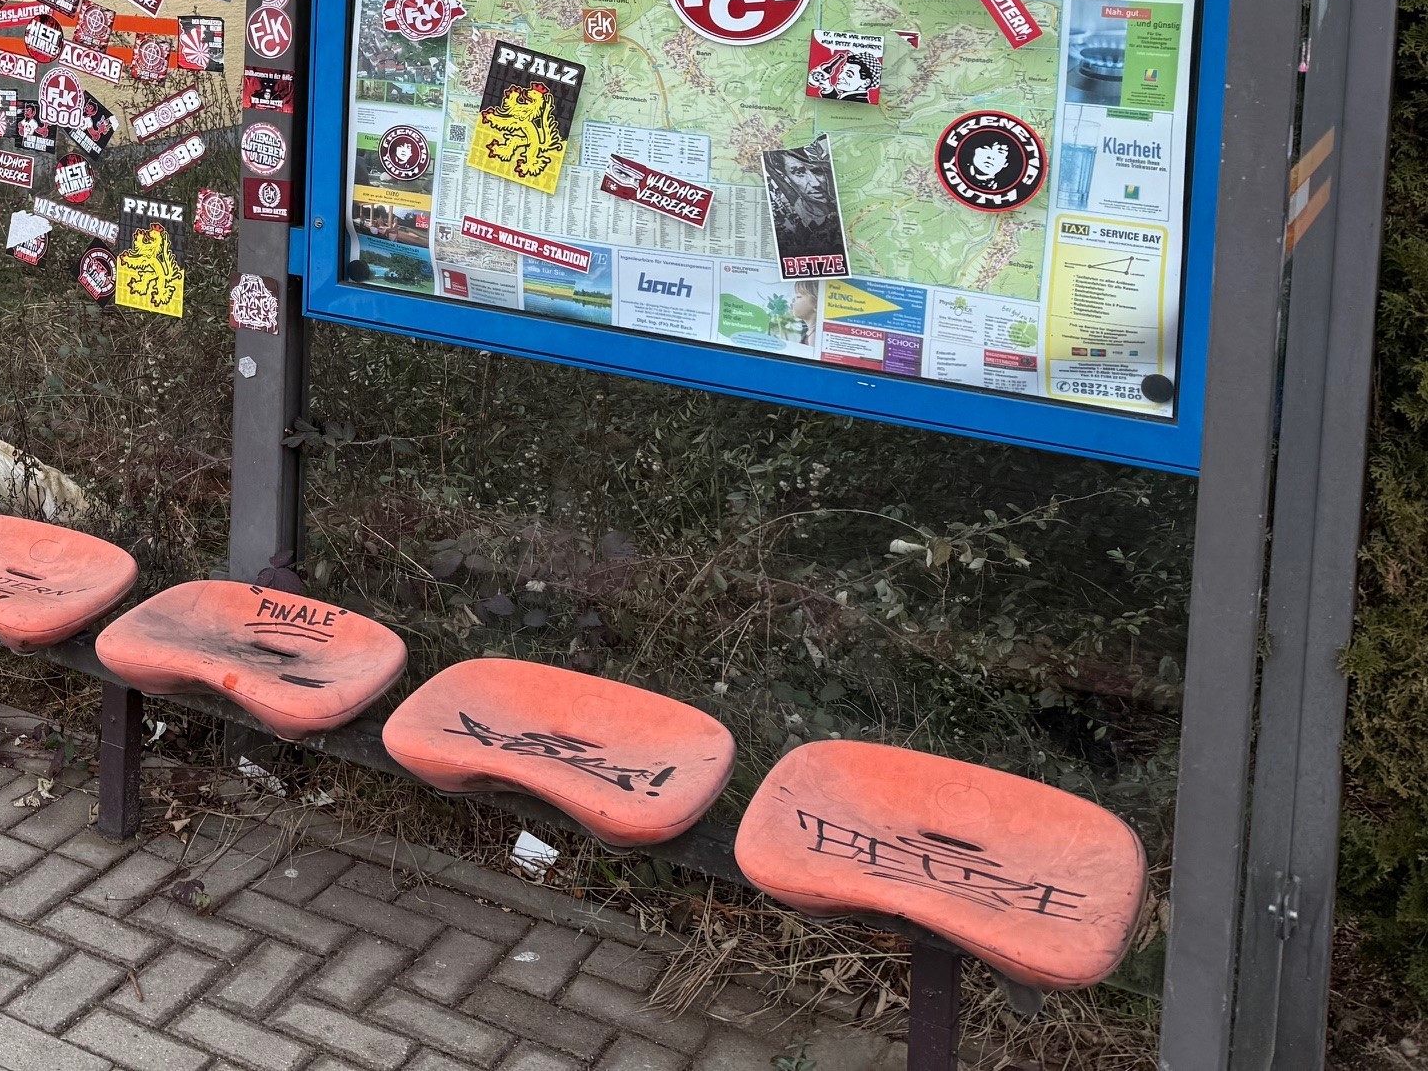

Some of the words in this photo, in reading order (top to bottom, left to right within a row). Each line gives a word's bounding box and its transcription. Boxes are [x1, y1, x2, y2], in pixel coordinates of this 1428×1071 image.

[1105, 8, 1124, 16] Nah.
[1153, 22, 1180, 31] günstig
[497, 48, 580, 85] PFALZ
[959, 56, 993, 64] Trippstadt
[612, 93, 648, 103] Oberarnbach
[40, 103, 82, 127] 1900
[242, 141, 285, 159] AUFGEBEN
[251, 132, 281, 147] NIEMALS
[1103, 137, 1162, 160] Klarheit
[250, 152, 279, 166] ULTRAS
[646, 173, 708, 203] WALDHOF
[943, 156, 1018, 205] YOUTH
[123, 198, 183, 221] PFALZ
[636, 186, 703, 219] VERRECKE
[34, 197, 120, 243] WESTKURVE
[463, 220, 588, 267] FRITZ-WALTER-STADION
[1063, 224, 1089, 235] TAXI
[1100, 228, 1140, 242] SERVICE
[1142, 230, 1161, 245] BAY
[784, 255, 845, 276] BETZE
[1009, 260, 1034, 270] Schopp
[638, 272, 693, 298] bach
[828, 293, 853, 303] JUNG
[851, 328, 882, 338] SCHOCH
[887, 338, 919, 348] SCHOCH
